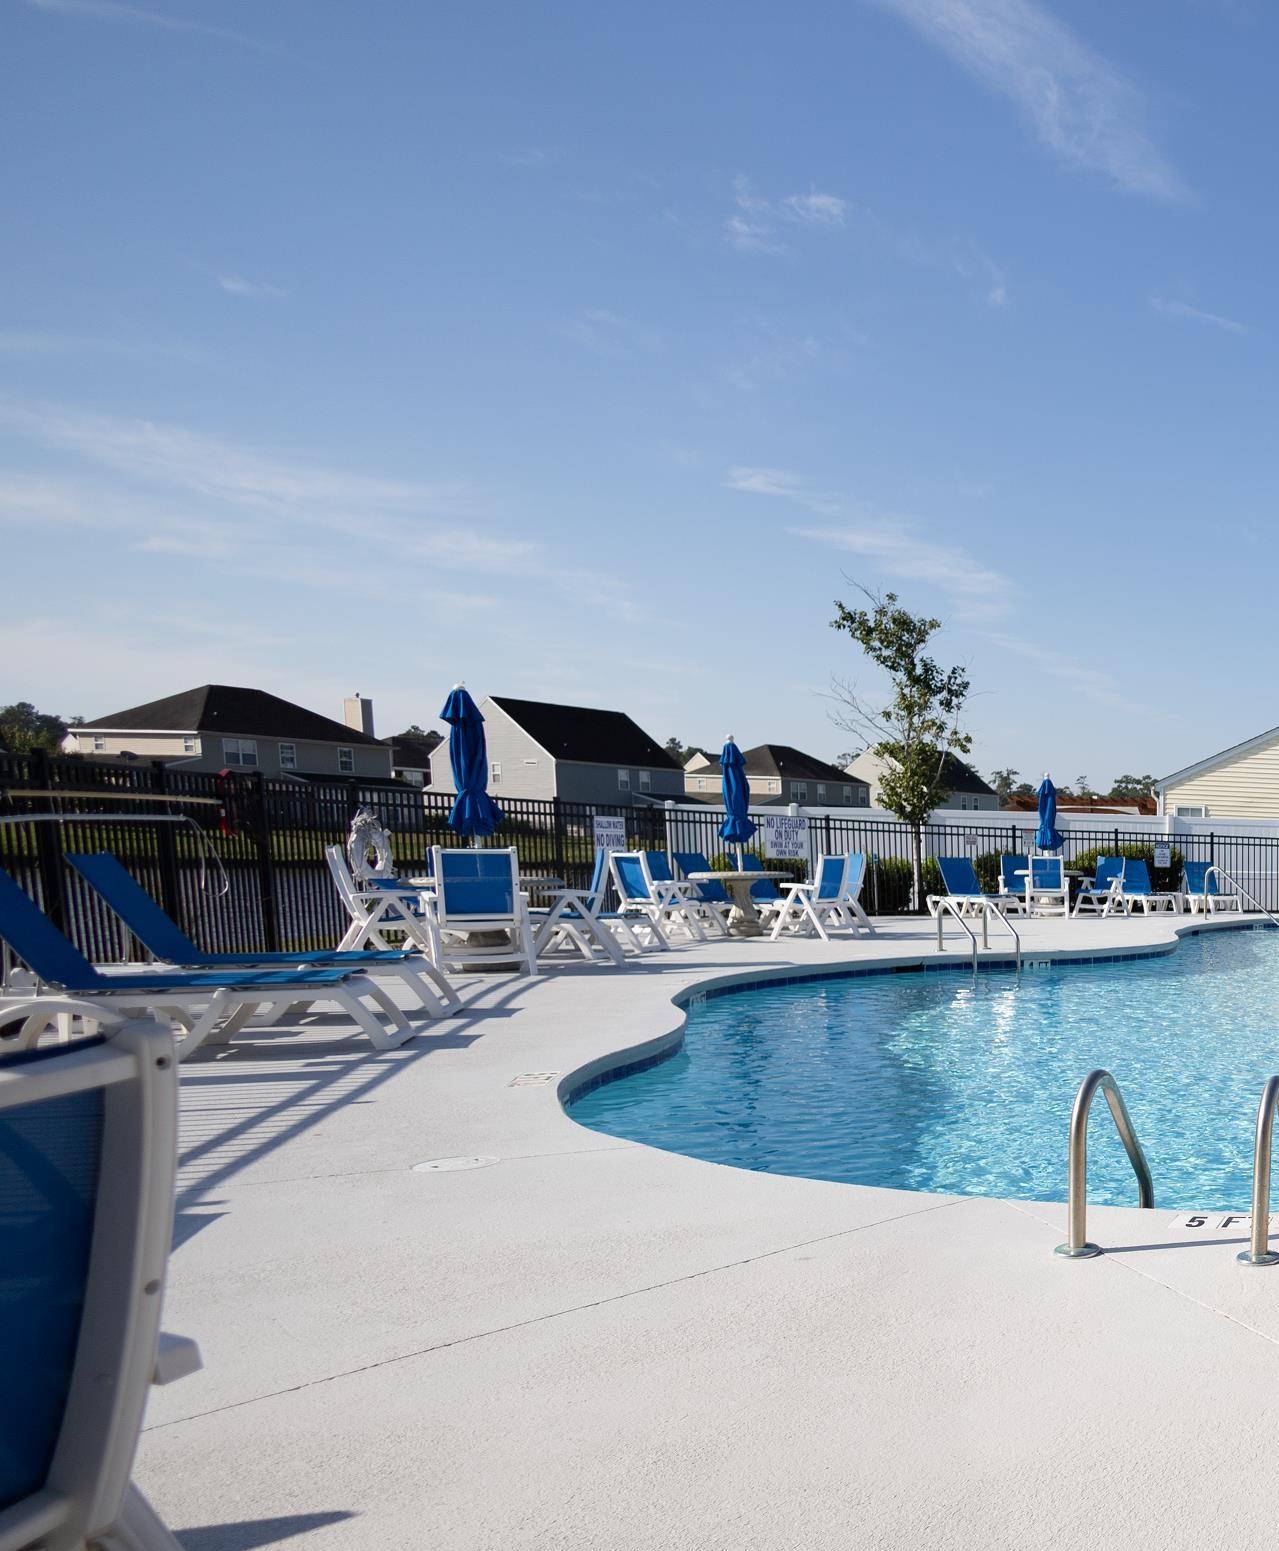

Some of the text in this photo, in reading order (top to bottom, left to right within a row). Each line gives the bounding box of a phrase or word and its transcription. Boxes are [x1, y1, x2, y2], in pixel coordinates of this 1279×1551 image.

[595, 820, 624, 829] SHALLOW WATER
[766, 817, 806, 830] NO LIFEGUARD
[596, 833, 624, 847] NO DIVING
[774, 829, 799, 841] ON DUTY
[770, 841, 804, 850] SWIM AT YOUR
[776, 849, 799, 857] OWN RISK
[1185, 1216, 1269, 1228] 5 F
